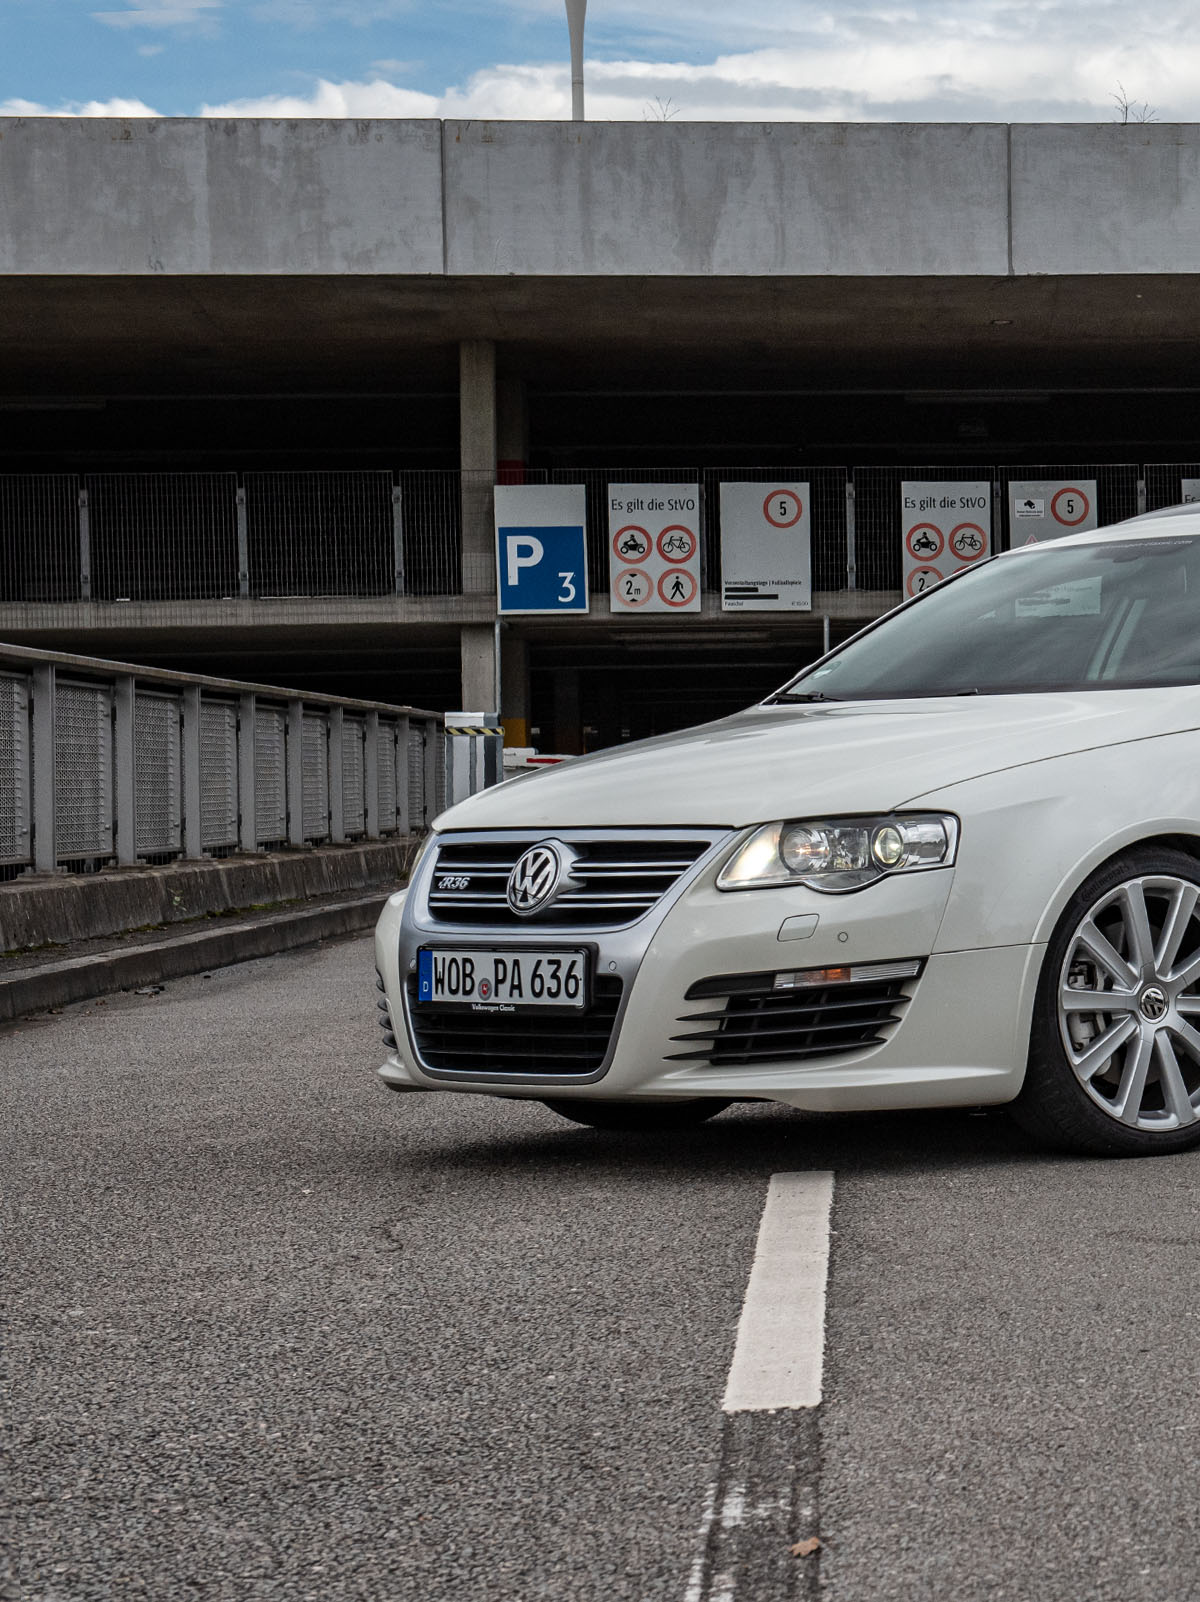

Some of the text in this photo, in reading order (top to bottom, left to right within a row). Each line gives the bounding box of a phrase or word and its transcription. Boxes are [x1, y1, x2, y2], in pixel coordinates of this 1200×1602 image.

[611, 498, 695, 513] Es gilt die StVO
[779, 501, 787, 516] 5
[904, 496, 986, 511] Es gilt die StVO
[1066, 499, 1074, 515] 5
[506, 535, 544, 586] P
[558, 571, 576, 602] 3
[438, 876, 471, 890] R36
[434, 957, 580, 999] WOB PA 636
[422, 981, 429, 992] D
[471, 1003, 515, 1012] Volkswagen Classic
